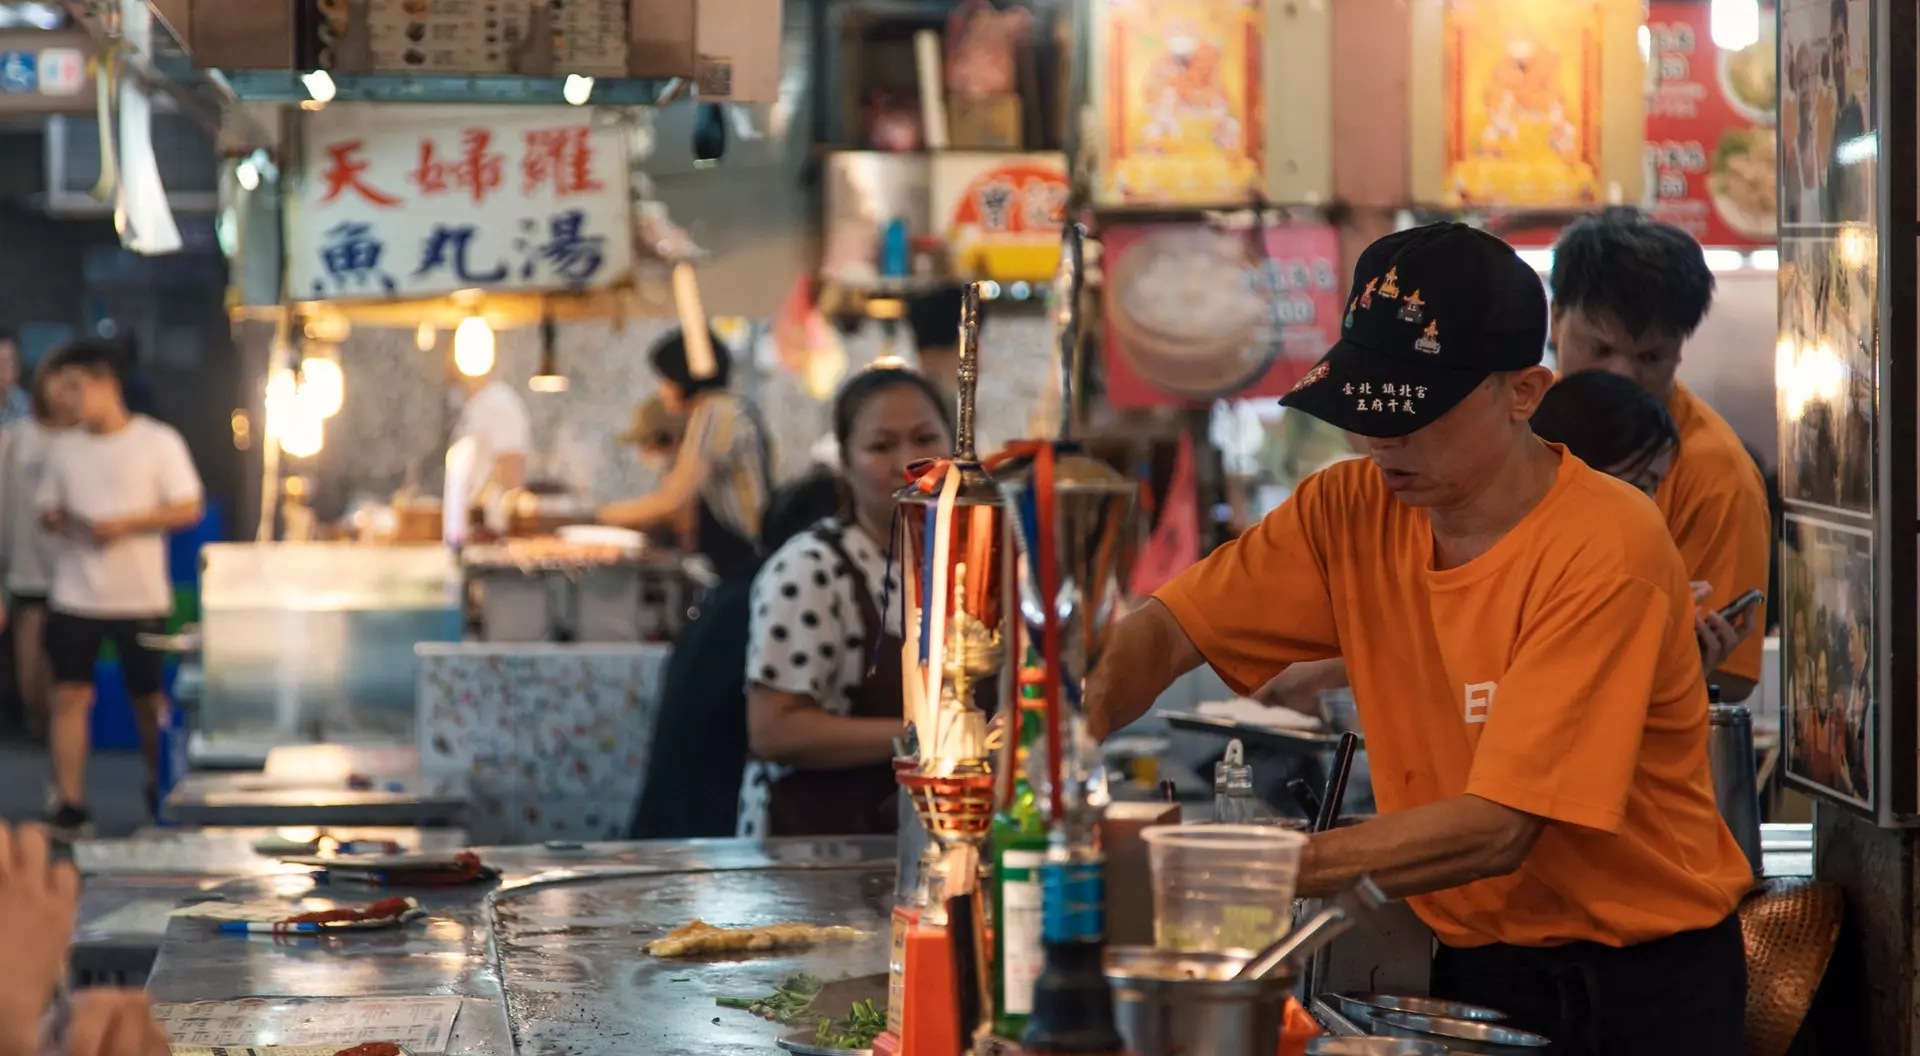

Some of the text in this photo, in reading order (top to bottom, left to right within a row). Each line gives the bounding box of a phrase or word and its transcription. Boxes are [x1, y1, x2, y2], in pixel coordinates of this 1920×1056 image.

[318, 126, 605, 208] 天婦羅
[312, 209, 607, 294] 魚丸湯
[1342, 382, 1428, 399] 臺北 鎮北宮
[1356, 398, 1416, 415] 五府千歲
